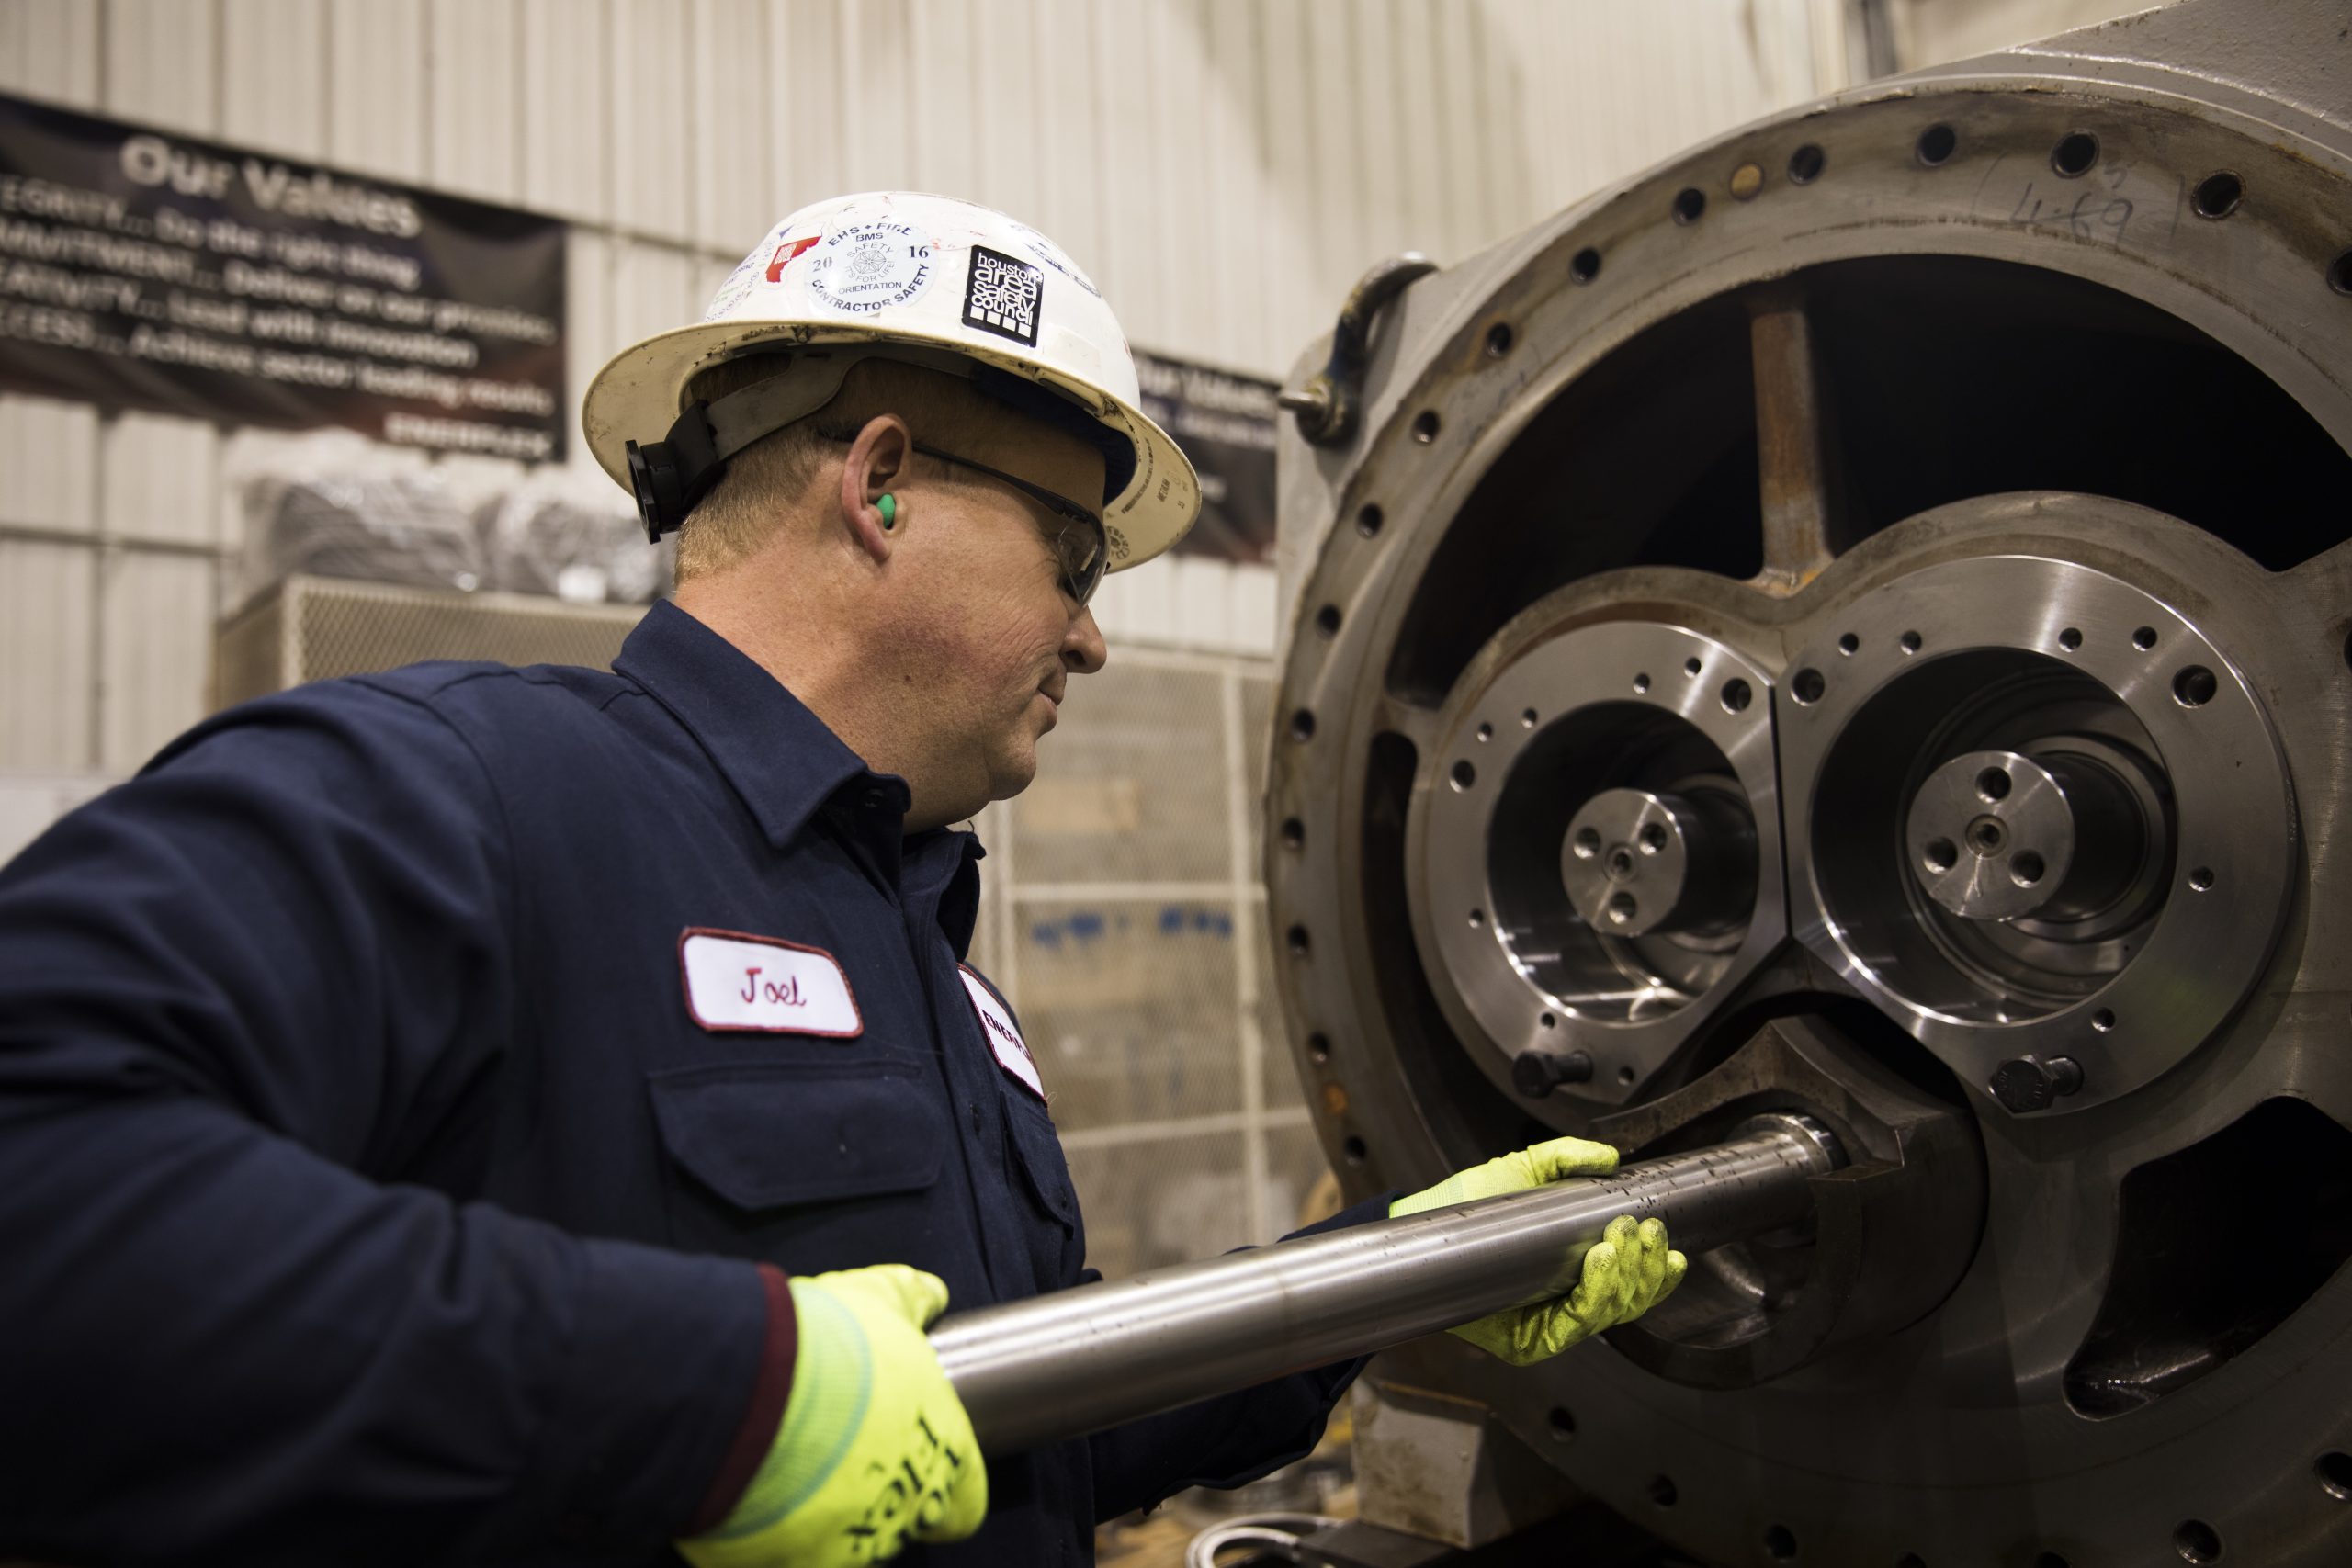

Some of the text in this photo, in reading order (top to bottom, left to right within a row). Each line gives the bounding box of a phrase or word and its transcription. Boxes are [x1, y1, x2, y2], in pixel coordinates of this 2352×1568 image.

[120, 135, 421, 238] Our Values
[208, 219, 264, 257] the
[828, 226, 860, 246] EHS
[846, 242, 894, 258] SAFETY
[855, 231, 883, 243] BMS
[812, 245, 929, 273] 20 16
[978, 252, 1037, 286] houston
[812, 278, 893, 312] CONTRACTOR
[894, 263, 930, 303] SAFETY
[838, 281, 902, 296] ORIENTATION
[855, 275, 876, 283] FOR
[974, 263, 1038, 301] area
[970, 293, 1035, 326] council
[972, 279, 1036, 313] safety
[741, 967, 807, 1007] Joel
